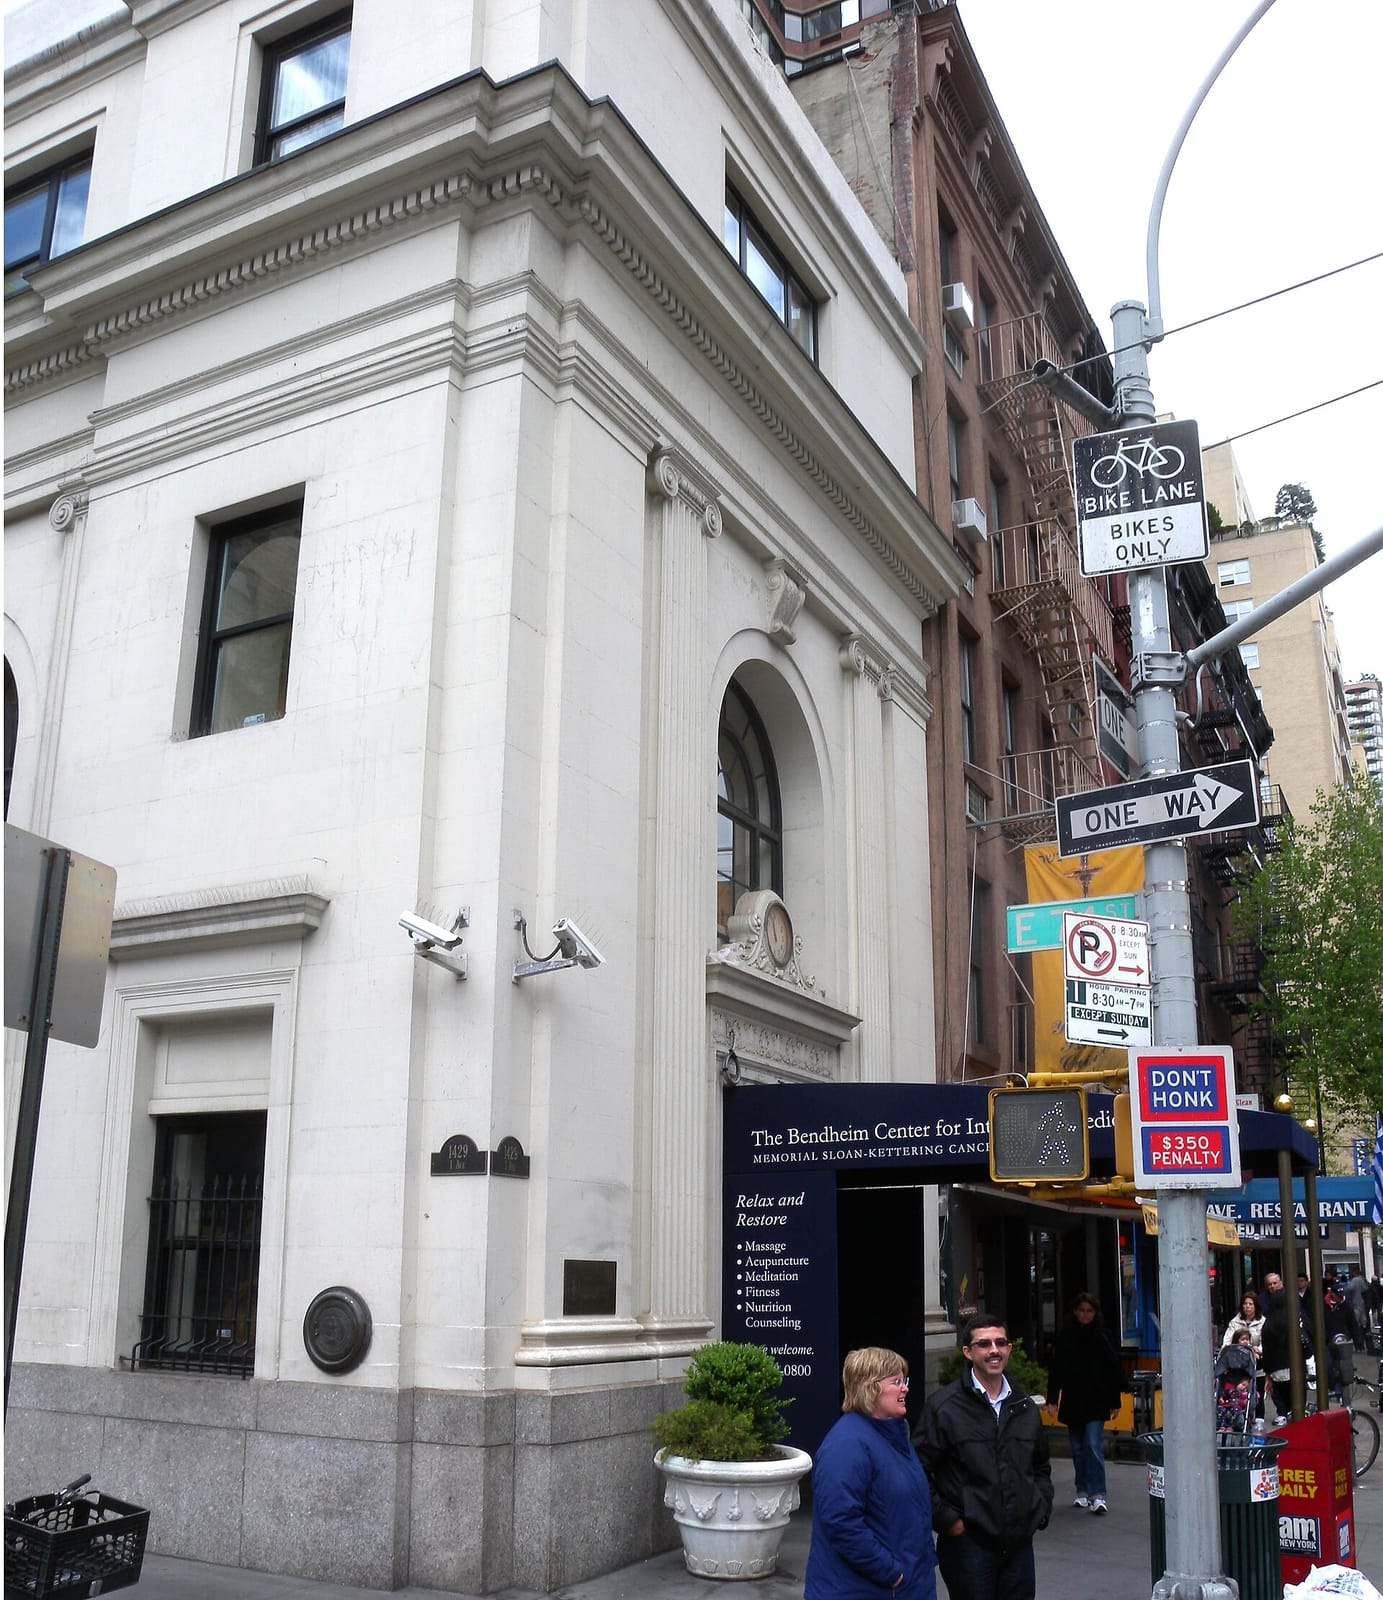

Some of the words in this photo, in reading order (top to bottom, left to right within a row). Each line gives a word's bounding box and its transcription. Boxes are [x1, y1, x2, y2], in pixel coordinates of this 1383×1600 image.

[1084, 491, 1132, 513] BIKE
[1141, 481, 1196, 504] LANE
[1110, 516, 1174, 540] BIKES
[1116, 538, 1171, 560] ONLY
[1103, 700, 1126, 746] ONE
[1085, 802, 1139, 833] ONE
[1164, 786, 1221, 818] WAY
[1015, 911, 1037, 946] E
[1119, 940, 1140, 949] EXCEPT
[1123, 951, 1138, 960] SUN
[1089, 983, 1110, 992] HOUR
[1114, 987, 1147, 996] PARKING
[1074, 1008, 1107, 1020] EXCEPT
[1110, 1014, 1145, 1027] SUNDAY
[1152, 1070, 1212, 1087] DON'T
[1153, 1091, 1214, 1108] HONK
[751, 1130, 783, 1147] The
[788, 1122, 869, 1145] Bendheim
[874, 1122, 931, 1139] Center
[935, 1117, 959, 1137] for
[965, 1117, 990, 1135] Int
[1162, 1136, 1209, 1150] $350
[448, 1143, 469, 1159] 1429
[753, 1152, 818, 1164] MEMORIAL
[822, 1147, 943, 1160] SLOAN-KETTERING
[1152, 1151, 1220, 1165] PENALTY
[735, 1194, 774, 1208] Relax
[778, 1192, 805, 1206] and
[1206, 1203, 1241, 1219] AVE.
[736, 1213, 788, 1227] Restore
[745, 1241, 786, 1253] Massage
[745, 1256, 809, 1269] Acupuncture
[745, 1271, 799, 1281] Meditation
[745, 1286, 780, 1297] Fitness
[745, 1302, 792, 1313] Nutrition
[745, 1316, 801, 1330] Counseling
[770, 1343, 814, 1355] welcome.
[1280, 1539, 1296, 1547] NEW
[1297, 1540, 1317, 1550] YORK
